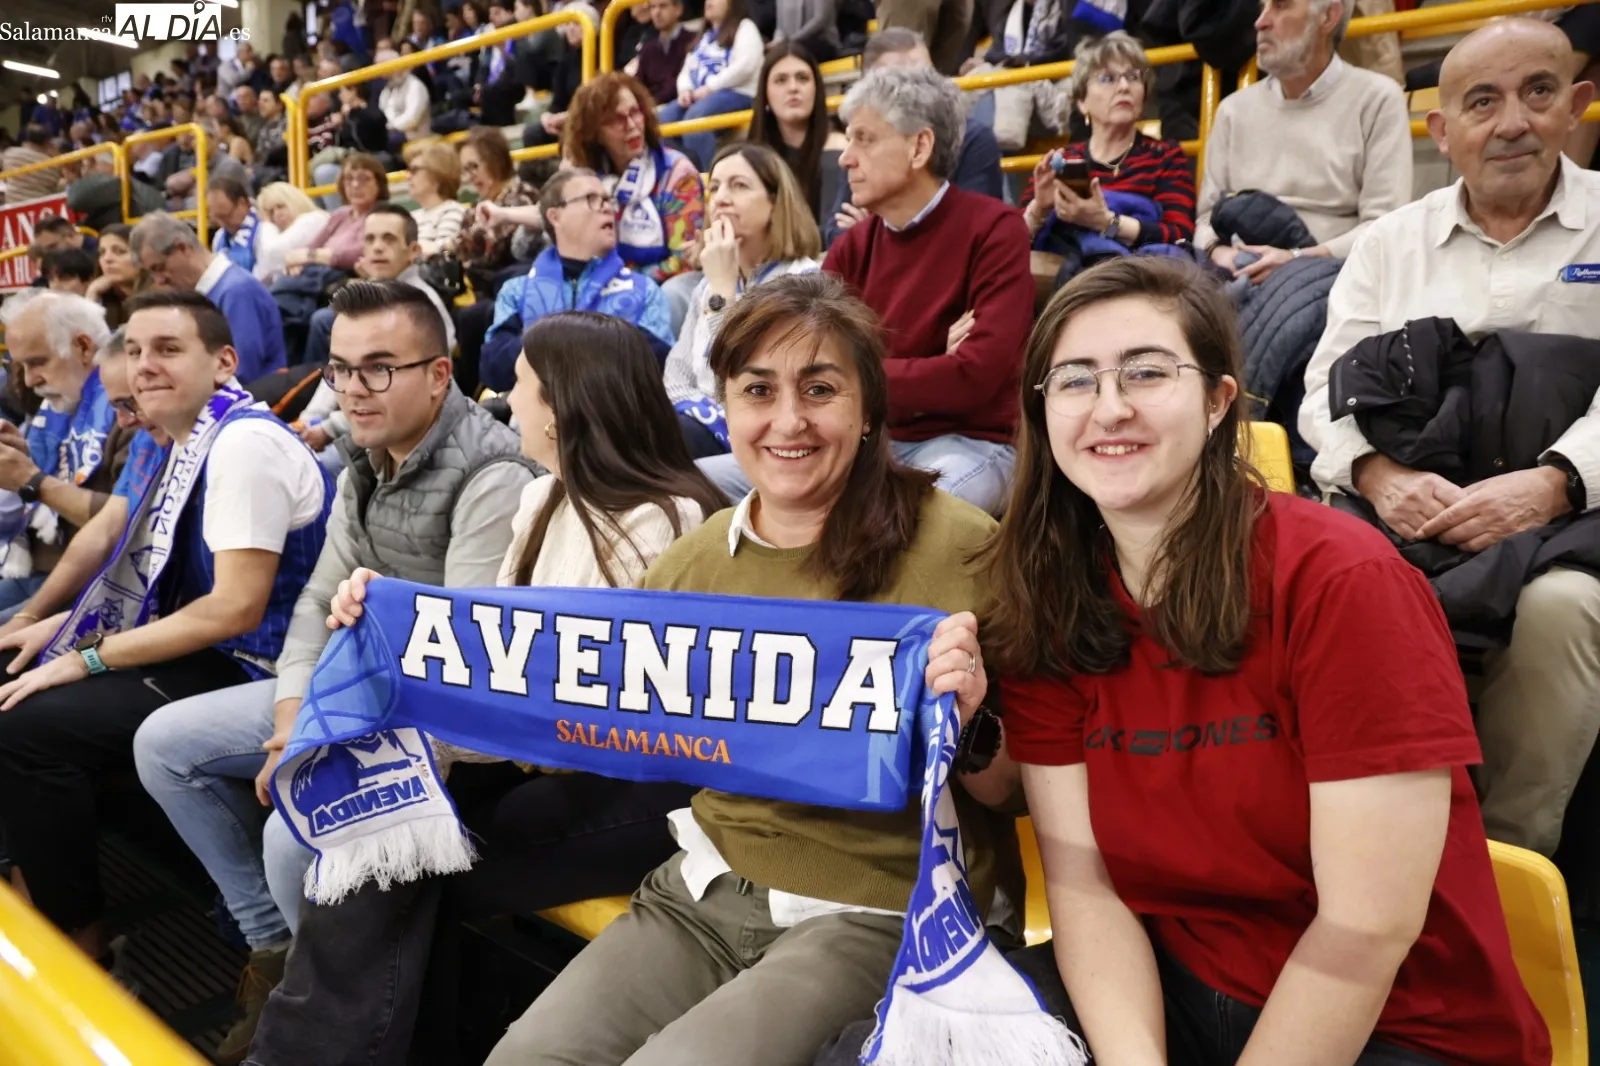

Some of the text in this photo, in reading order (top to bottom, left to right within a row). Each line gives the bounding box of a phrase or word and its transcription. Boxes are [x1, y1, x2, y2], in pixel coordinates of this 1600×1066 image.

[400, 593, 900, 733] AVENIDA
[556, 719, 732, 764] SALAMANCA
[1166, 713, 1279, 752] ONES
